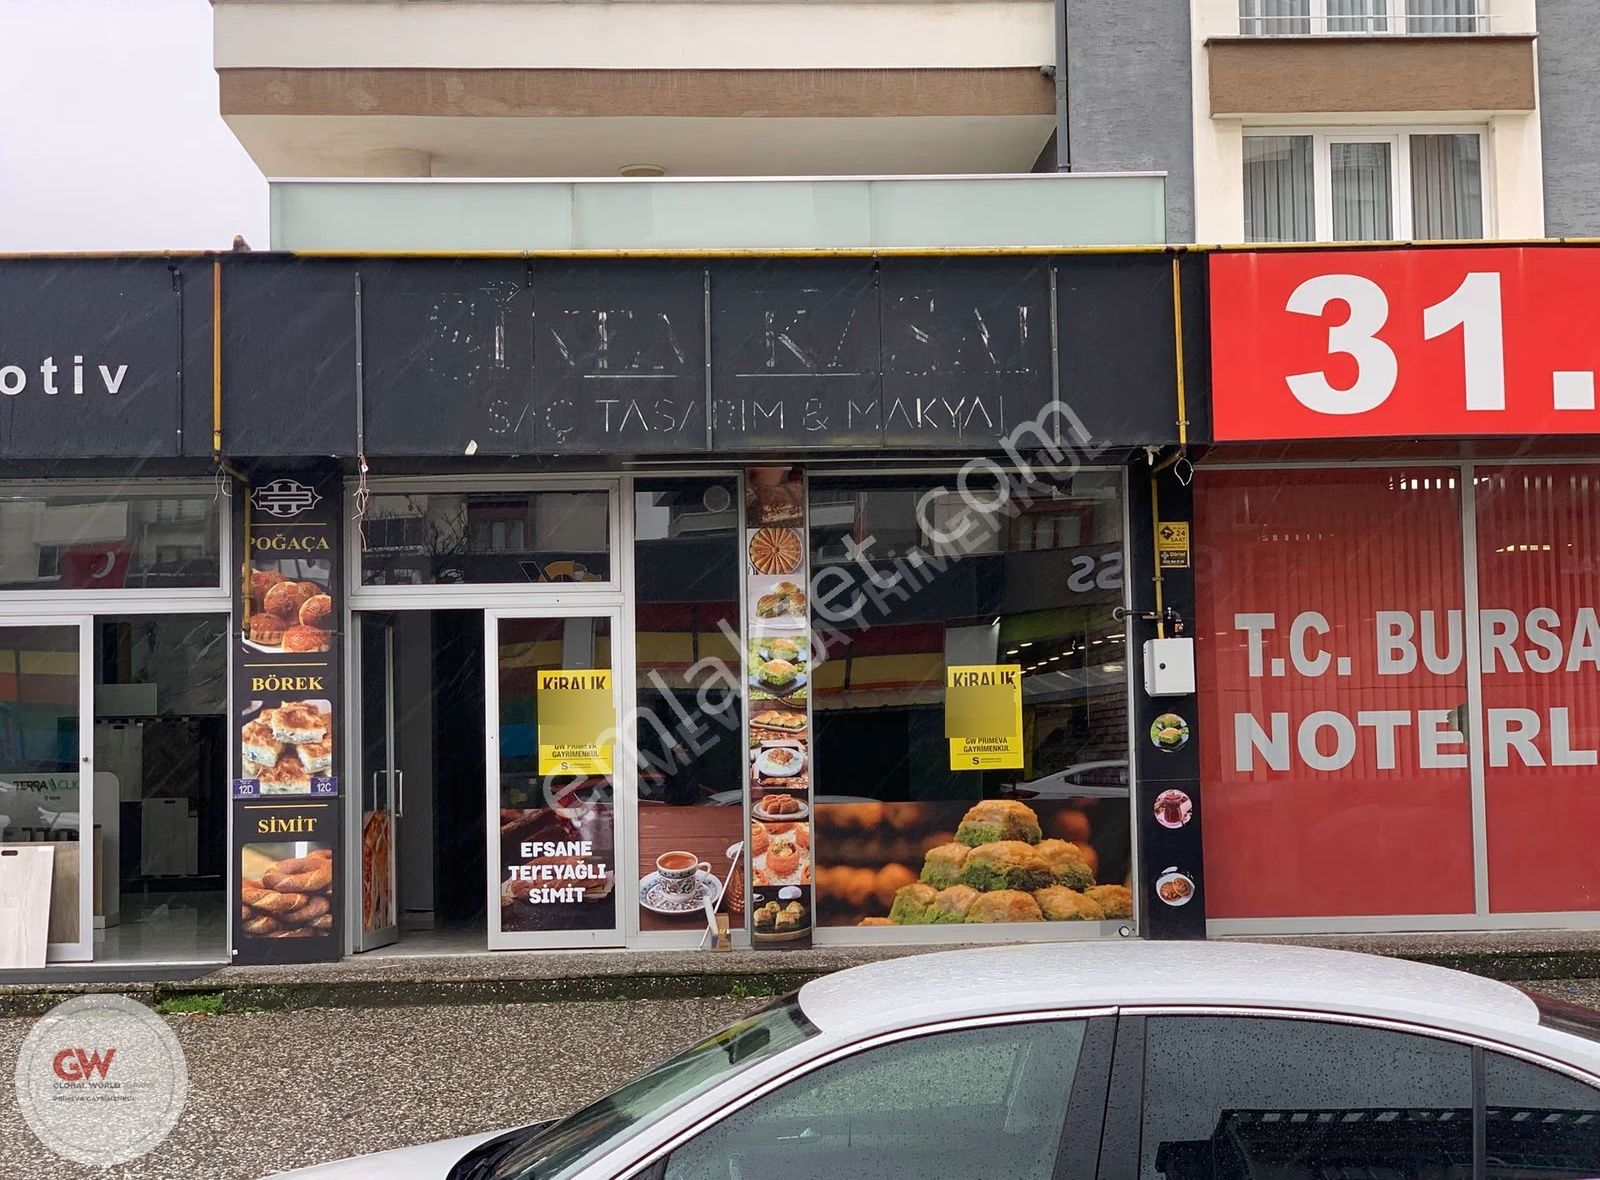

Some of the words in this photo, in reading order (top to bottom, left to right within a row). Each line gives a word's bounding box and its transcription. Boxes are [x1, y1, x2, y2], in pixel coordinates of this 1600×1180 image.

[1285, 271, 1596, 416] 31.
[1234, 611, 1351, 677] T.C.
[1376, 607, 1600, 675] BURSA
[252, 674, 324, 691] BÖREK
[1234, 707, 1598, 772] NOTERL
[13, 780, 48, 792] TERRA
[239, 785, 254, 794] 12D
[317, 783, 332, 792] 12C
[258, 816, 317, 833] SİMİT
[521, 841, 592, 857] EFSANE
[529, 884, 585, 904] SİMİT
